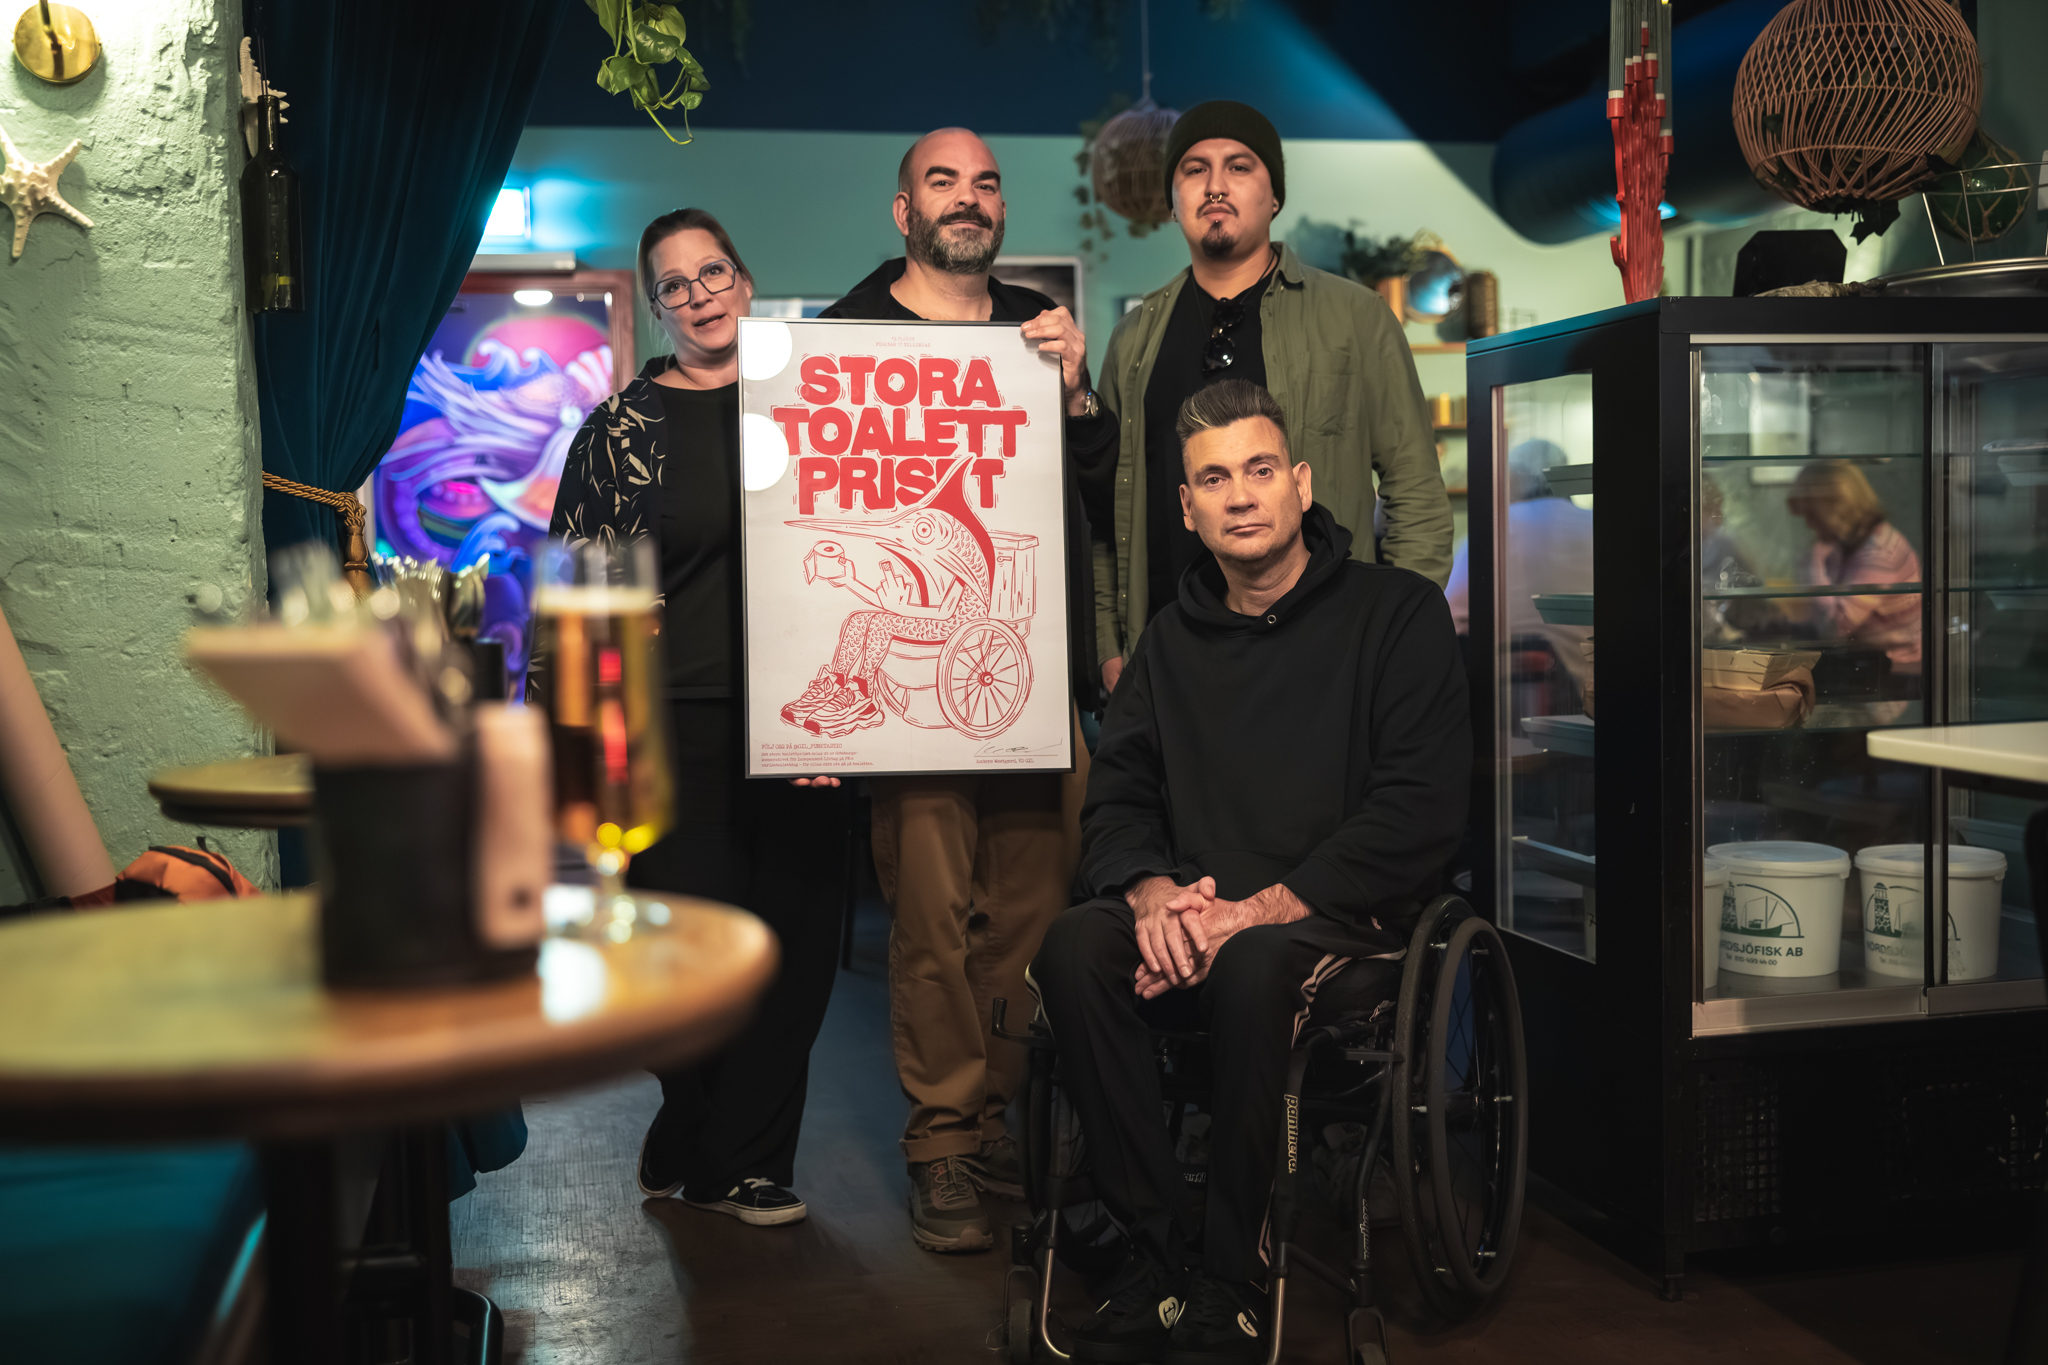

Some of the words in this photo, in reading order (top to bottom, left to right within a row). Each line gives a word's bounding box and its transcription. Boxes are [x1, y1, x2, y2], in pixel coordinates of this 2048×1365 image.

[800, 356, 1002, 408] STORA
[773, 406, 1027, 458] TOALETT
[1785, 946, 1804, 957] AB
